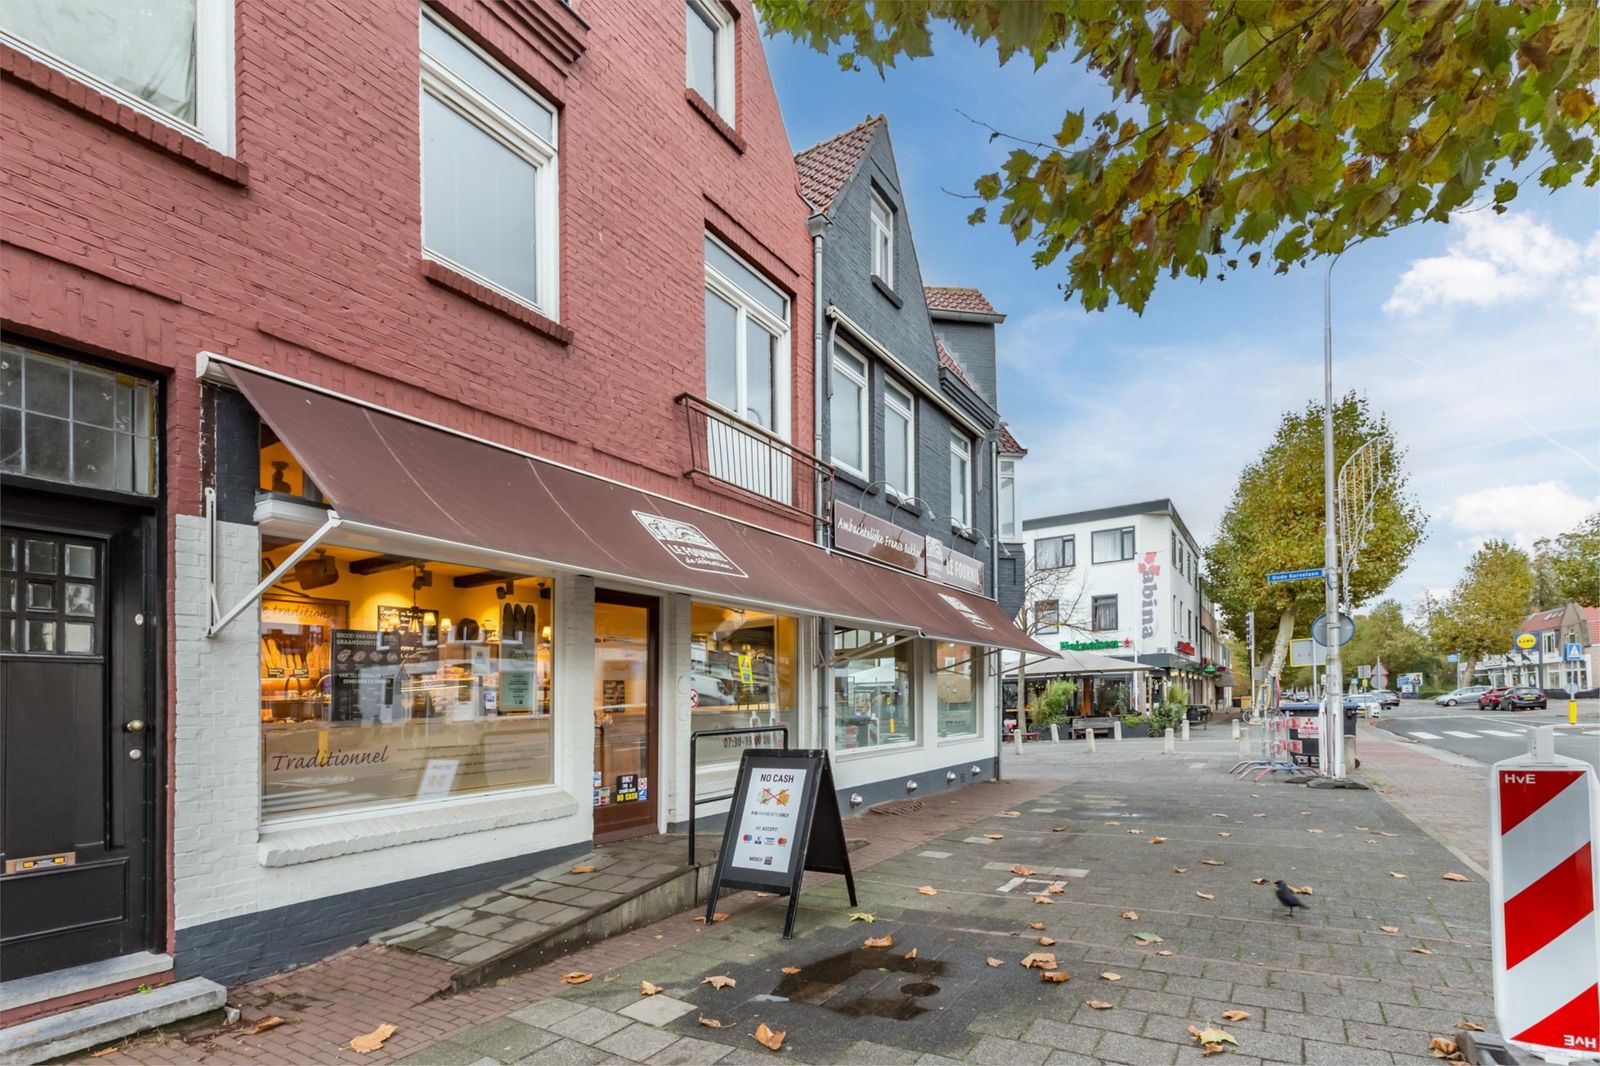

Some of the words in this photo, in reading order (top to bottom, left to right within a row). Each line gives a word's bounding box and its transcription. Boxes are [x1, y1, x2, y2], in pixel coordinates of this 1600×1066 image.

[666, 543, 687, 556] LE
[1060, 639, 1120, 651] Heineken
[272, 745, 389, 772] Traditionnel
[760, 774, 772, 782] NO
[772, 774, 795, 783] CASH
[1504, 773, 1536, 784] HvE
[616, 794, 624, 802] NO
[625, 792, 638, 801] CASH
[1563, 1034, 1597, 1048] HvE
